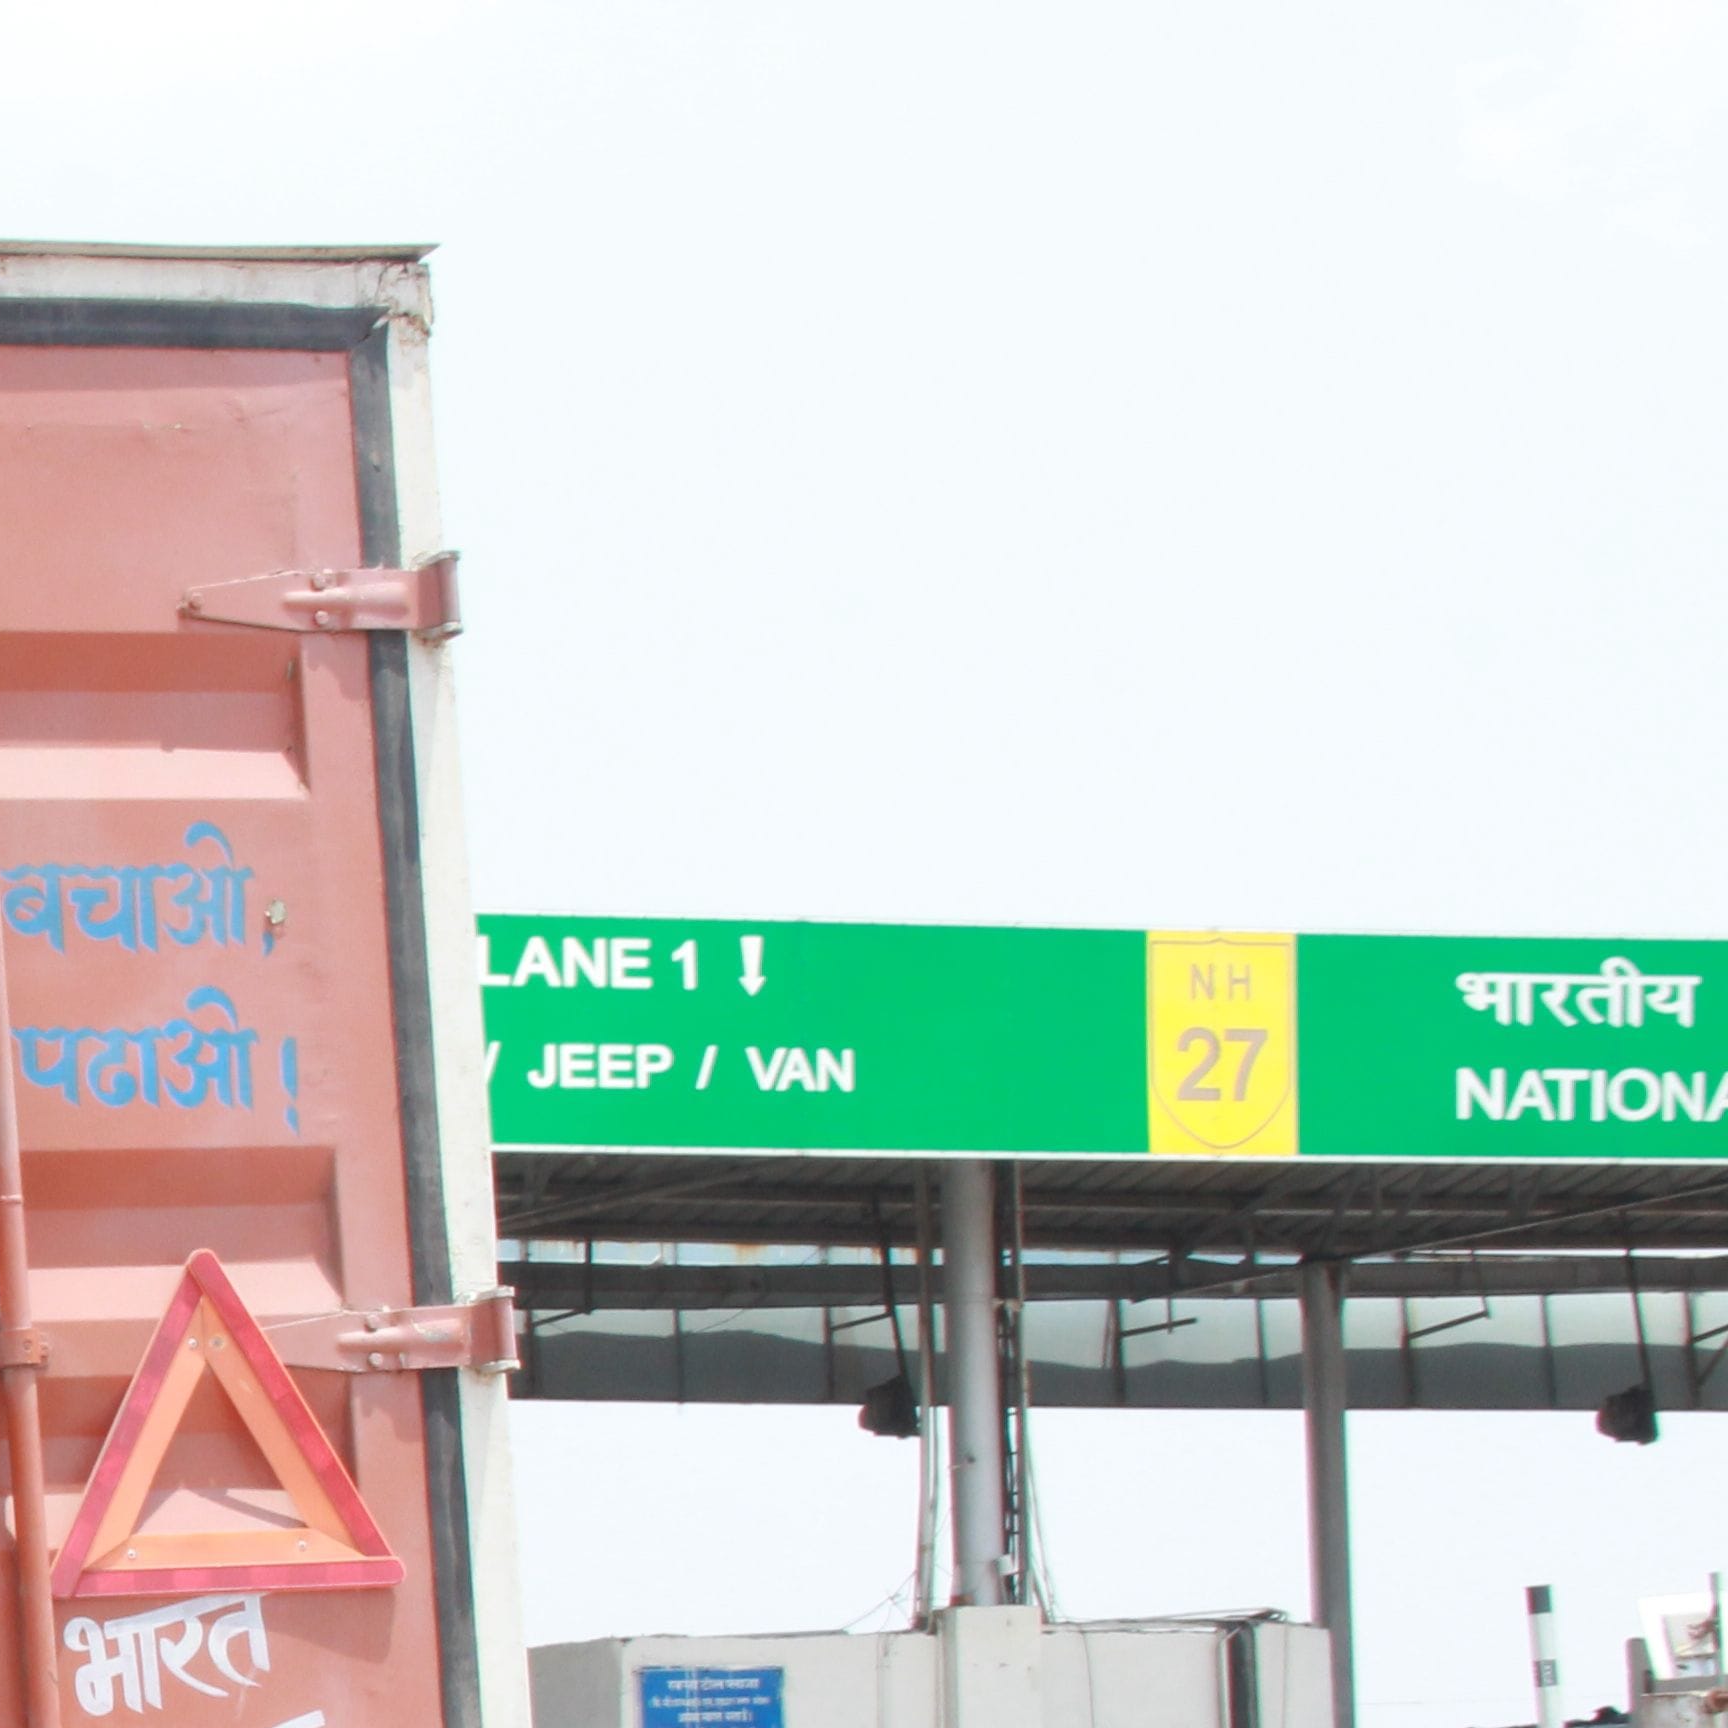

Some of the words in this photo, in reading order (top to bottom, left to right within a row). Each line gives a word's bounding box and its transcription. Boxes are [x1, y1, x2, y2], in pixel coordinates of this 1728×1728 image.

[476, 934, 654, 990] LANE
[670, 939, 699, 991] 1
[1189, 963, 1252, 1003] NH
[1454, 955, 1704, 1029] भारतीय
[526, 1043, 675, 1090] JEEP
[745, 1046, 856, 1093] VAN
[1175, 1027, 1269, 1102] 27
[63, 1593, 272, 1718] भारत
